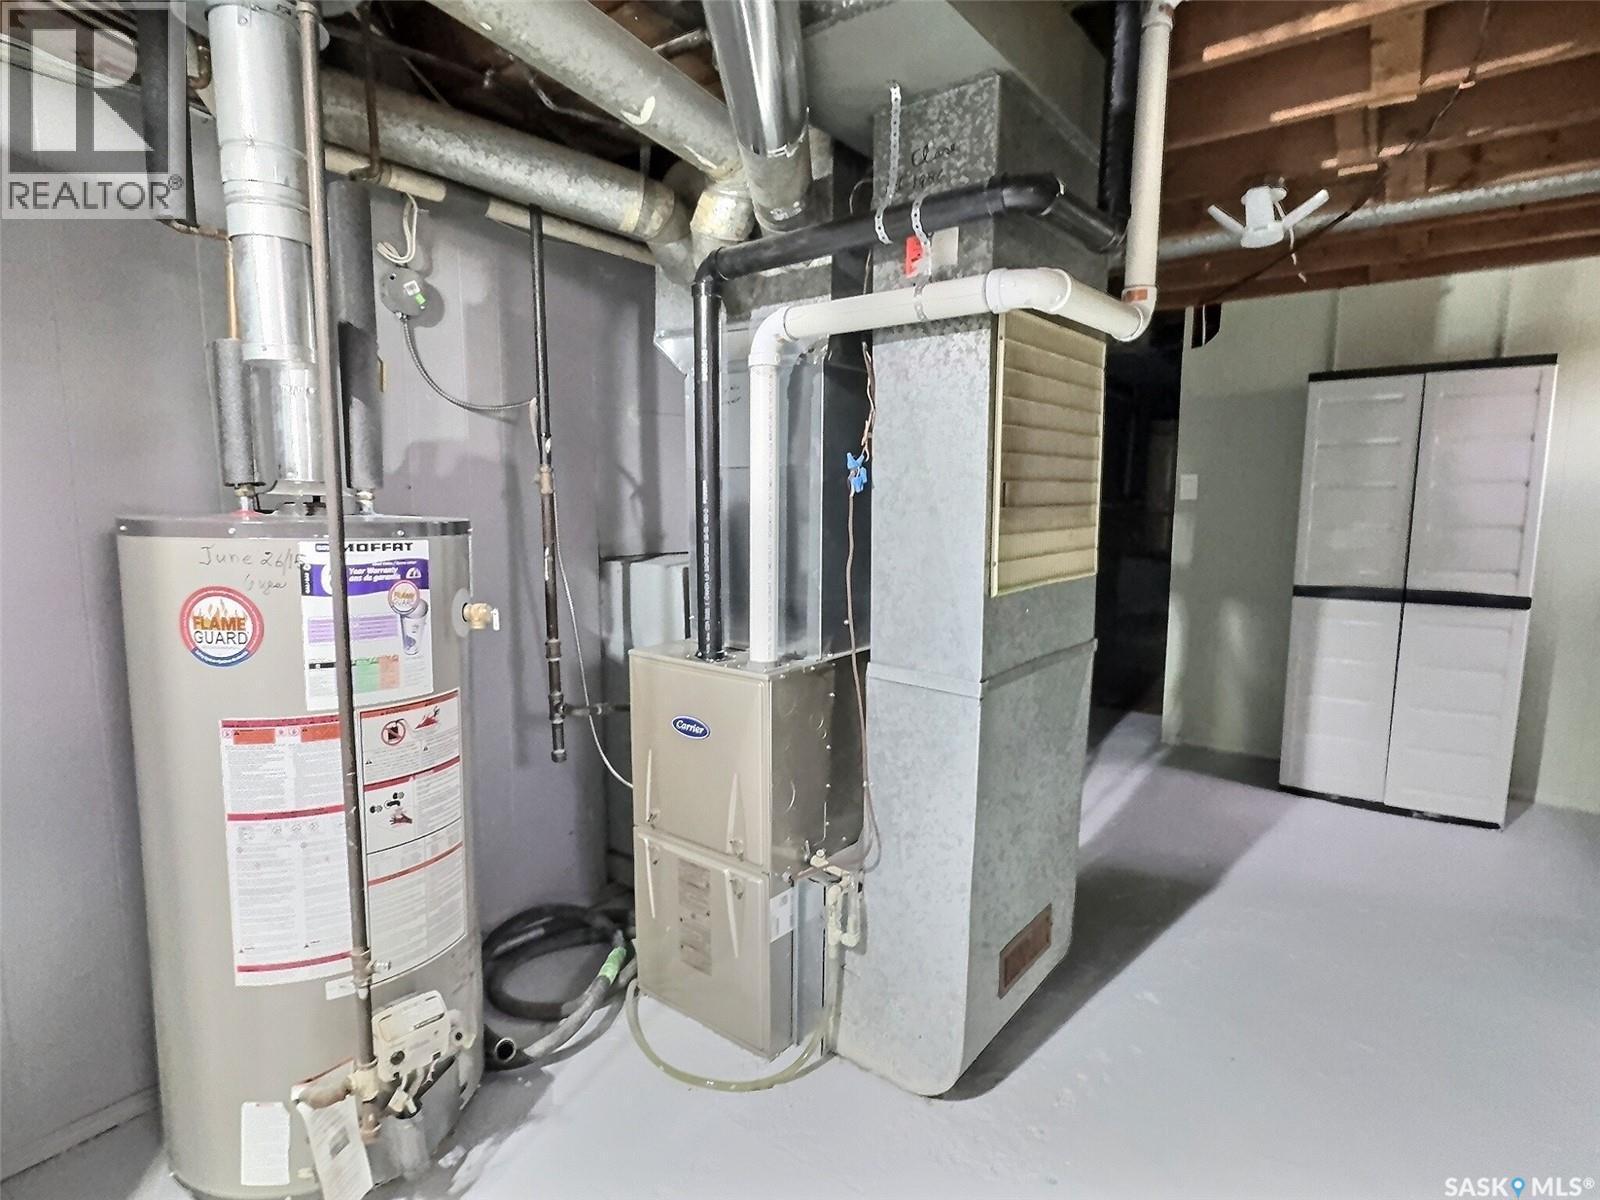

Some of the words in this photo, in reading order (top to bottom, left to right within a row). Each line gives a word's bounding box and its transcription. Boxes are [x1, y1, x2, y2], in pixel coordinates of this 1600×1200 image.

[199, 544, 253, 566] June
[192, 615, 247, 631] FLAME
[193, 630, 249, 645] GUARD
[675, 719, 705, 734] Carrier
